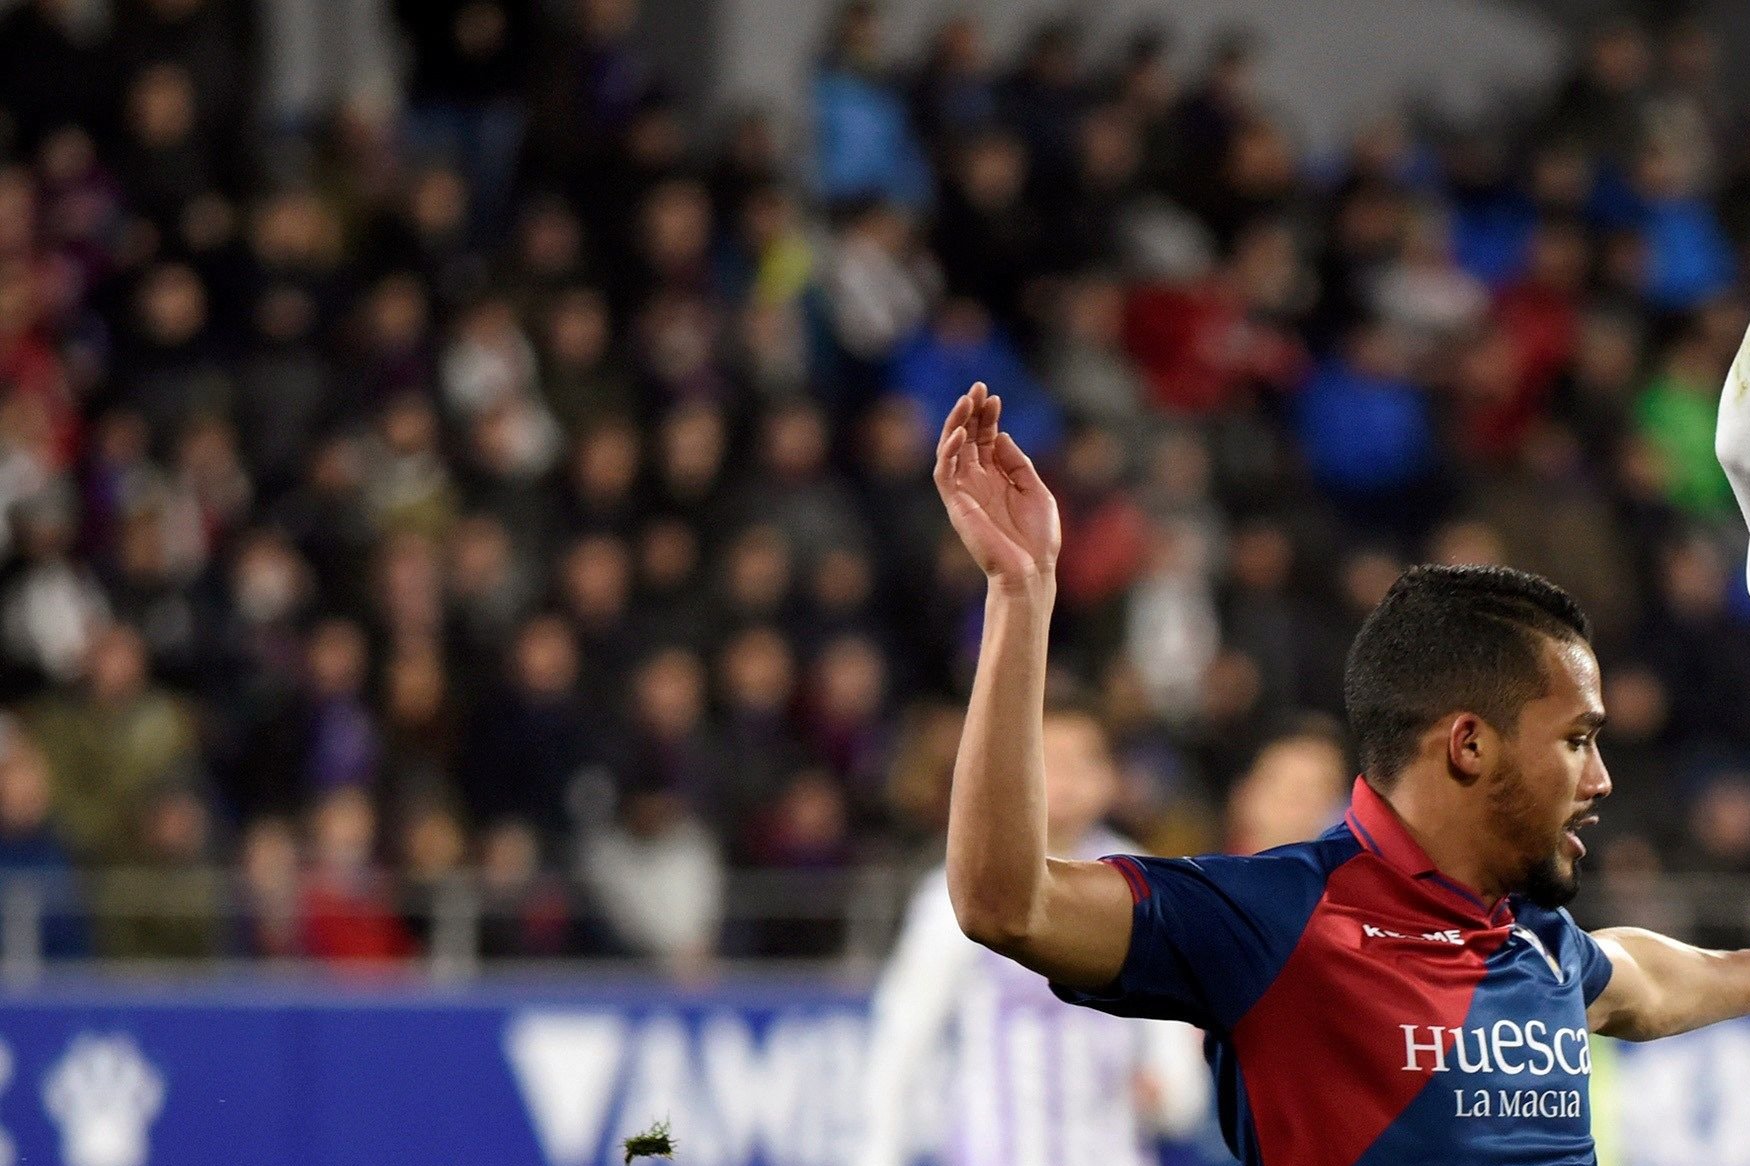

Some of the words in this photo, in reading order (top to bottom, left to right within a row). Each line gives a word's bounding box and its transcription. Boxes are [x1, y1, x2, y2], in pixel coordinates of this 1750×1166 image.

[1362, 923, 1466, 946] KME
[1398, 1019, 1593, 1076] Huesca
[1453, 1089, 1492, 1118] La
